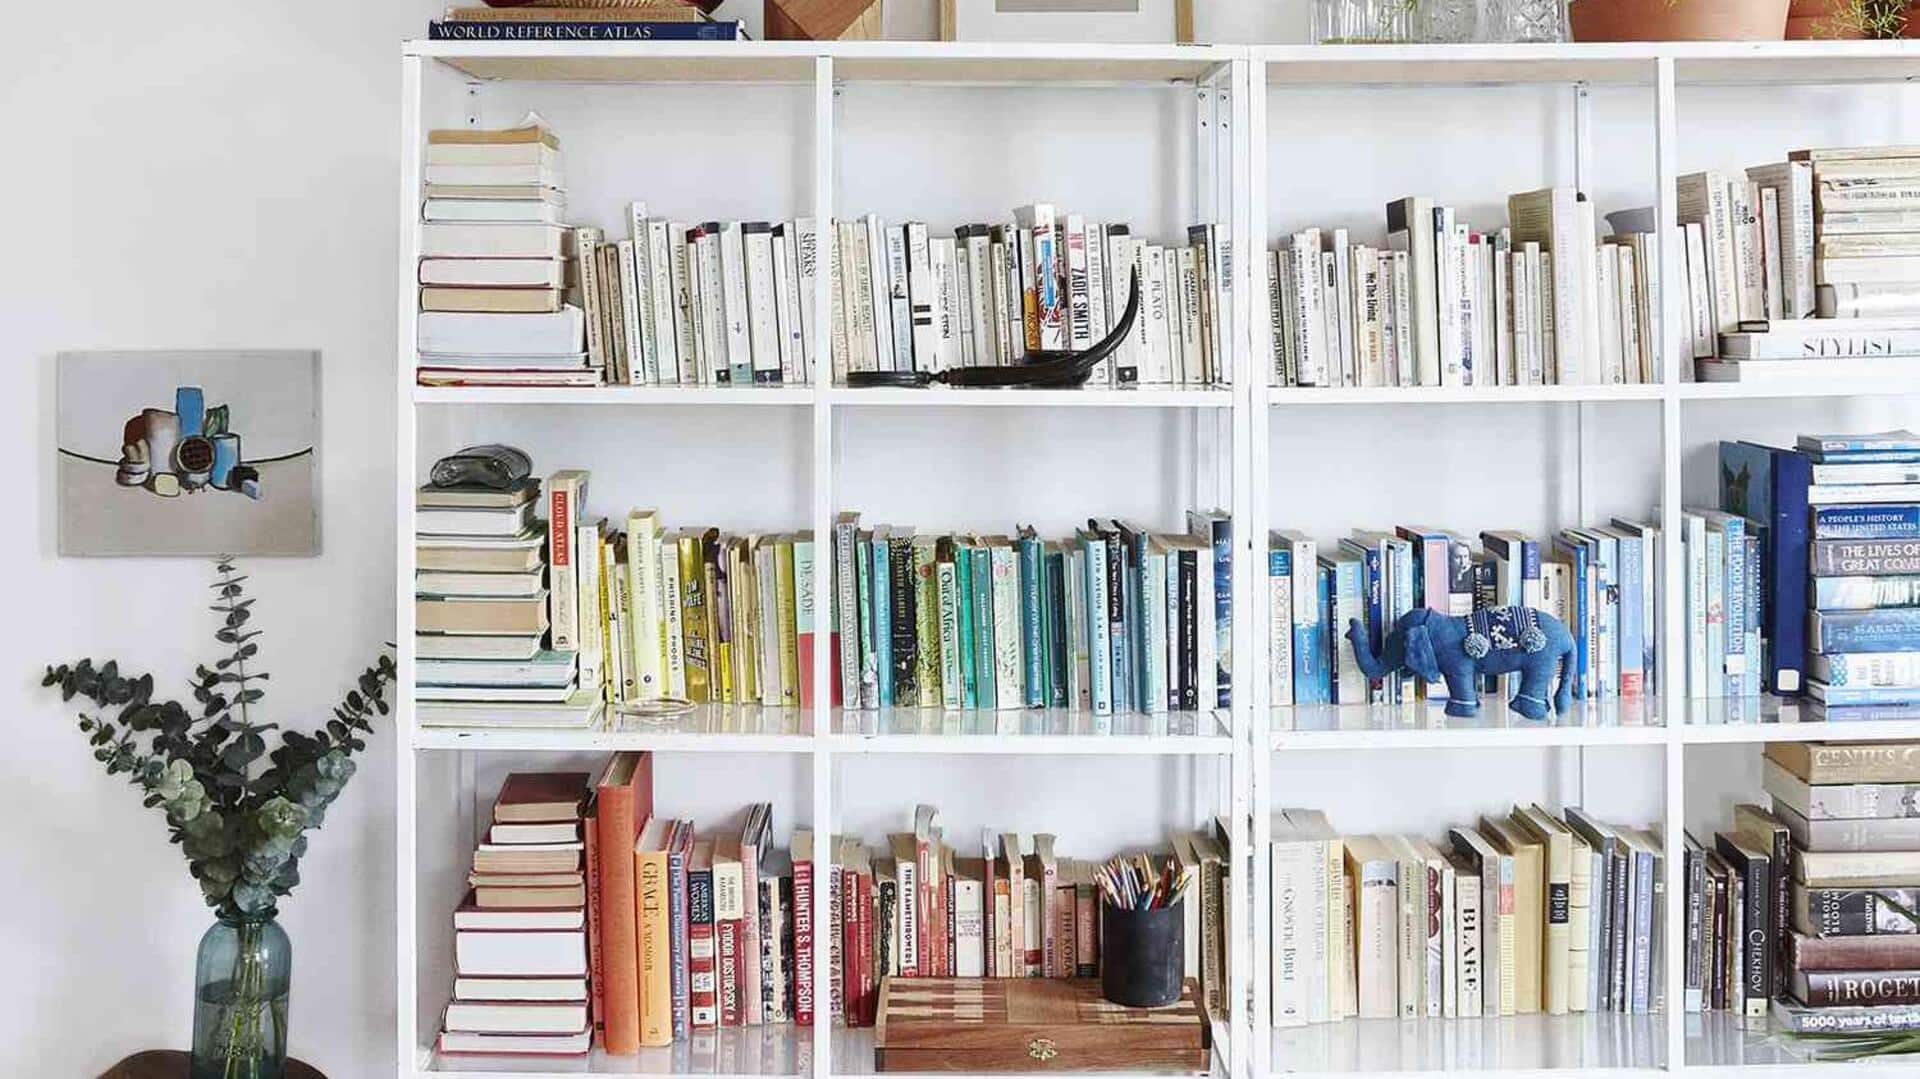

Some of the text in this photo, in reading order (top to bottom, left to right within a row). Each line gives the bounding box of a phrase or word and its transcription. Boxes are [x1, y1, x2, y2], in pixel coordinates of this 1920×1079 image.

[437, 25, 651, 38] WORLD REFERENCE ATLAS
[1071, 268, 1088, 299] ZADIE
[1366, 272, 1379, 322] We The Living
[1074, 302, 1090, 340] SMITH
[554, 494, 565, 528] CLOUD
[1819, 513, 1904, 523] A PEOPLE'S HISTORY
[1851, 523, 1886, 532] UNITED
[1840, 543, 1920, 558] THE LIVES OF
[1841, 560, 1880, 572] GREAT
[941, 571, 953, 592] Out
[1732, 532, 1745, 654] THE FOOD REVOLUTION
[667, 577, 677, 623] PHISHING
[942, 593, 954, 607] of
[942, 609, 956, 643] Africa
[1816, 749, 1895, 767] GENIUS
[642, 861, 660, 919] GRACE
[905, 869, 913, 885] THE
[690, 881, 701, 922] WOMEN
[700, 881, 710, 922] AMERICAN
[1822, 891, 1831, 934] HAROLD
[1831, 891, 1840, 933] BLOOM
[673, 872, 686, 995] The Future Dictionary of America
[722, 923, 735, 956] FYODOR
[1063, 911, 1073, 934] THE
[644, 930, 653, 972] MEMOIR
[796, 885, 812, 1013] HUNTER S. THOMPSON
[1462, 907, 1477, 992] BLAKE
[1749, 929, 1766, 992] CHEKHOV
[1801, 1016, 1836, 1027] 5000
[1837, 1016, 1872, 1030] years
[1873, 1013, 1887, 1026] of
